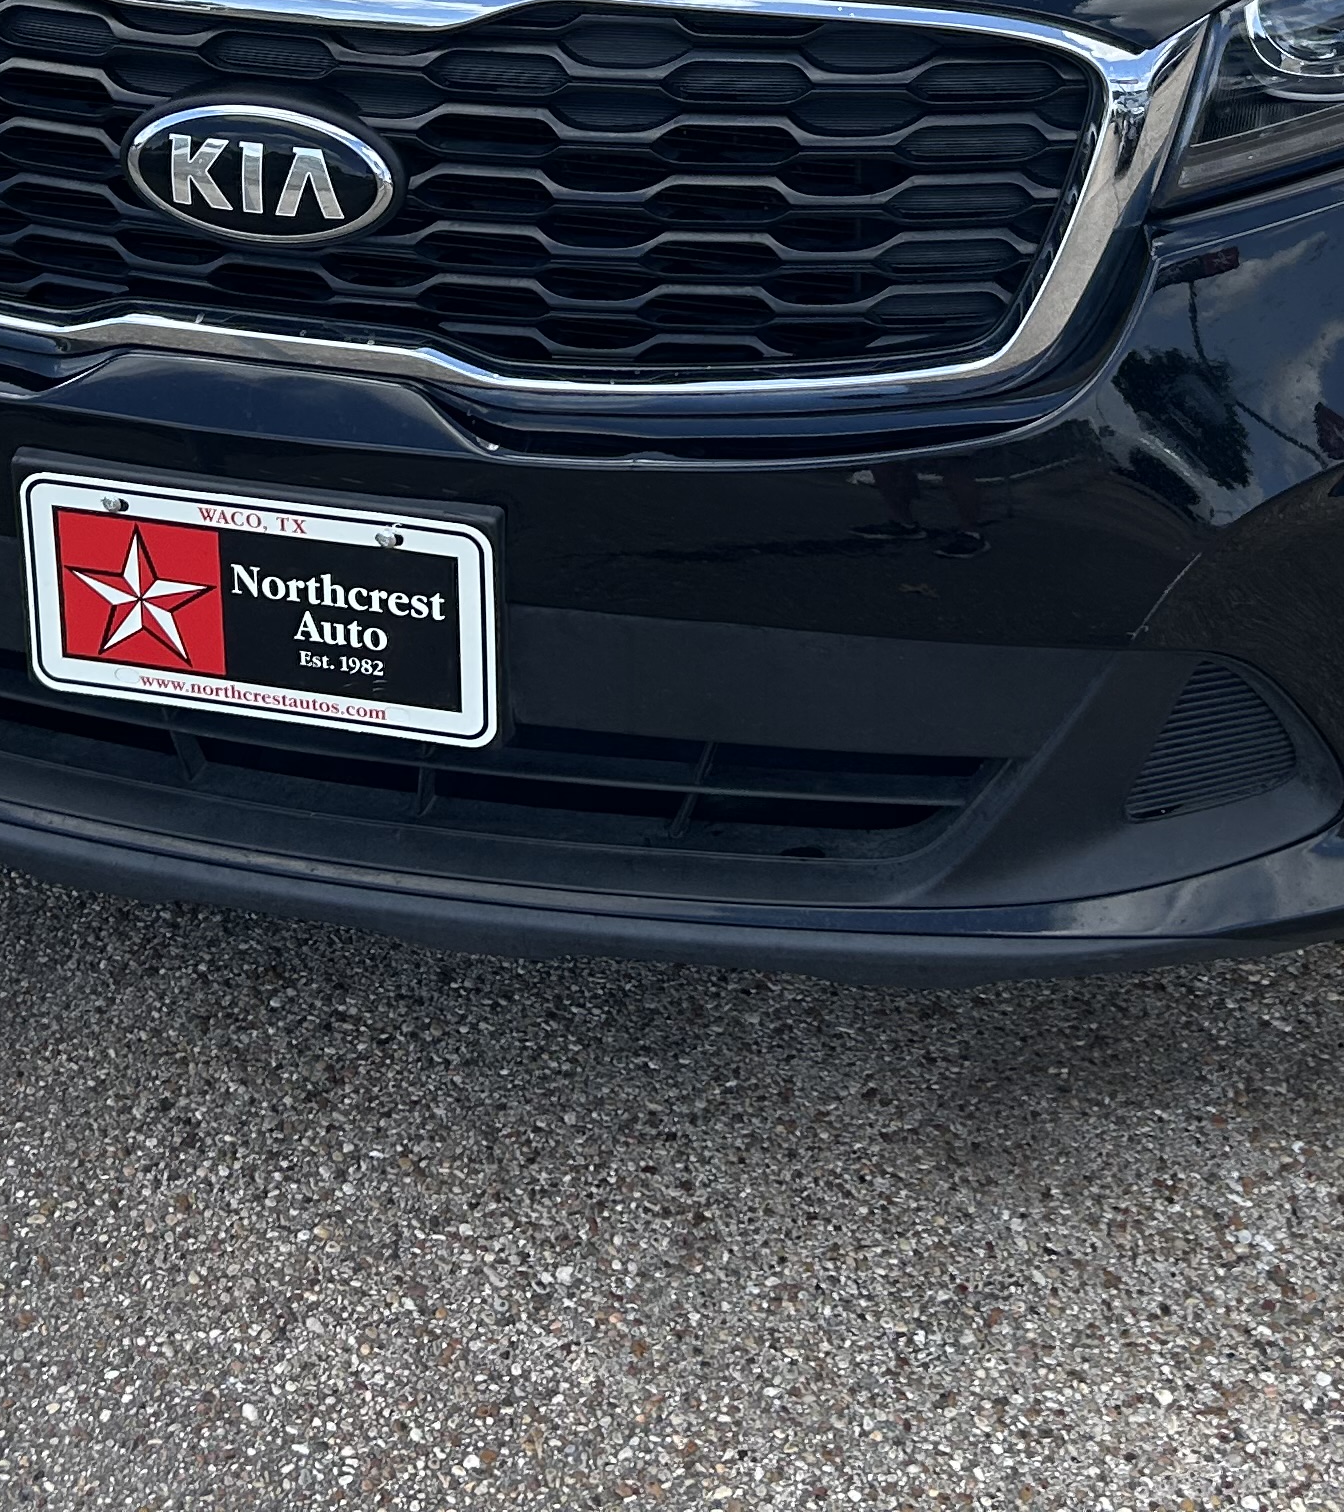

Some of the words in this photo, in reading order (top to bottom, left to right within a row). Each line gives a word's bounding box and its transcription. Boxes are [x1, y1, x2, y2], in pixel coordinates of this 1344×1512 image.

[169, 133, 345, 220] KIA
[197, 506, 268, 533] WACO,
[276, 517, 308, 535] TX
[230, 563, 446, 622] Northcrest
[294, 610, 389, 652] Auto
[299, 650, 336, 671] Est.
[339, 655, 385, 677] 1982
[140, 675, 389, 722] www.northcrestautos.com
